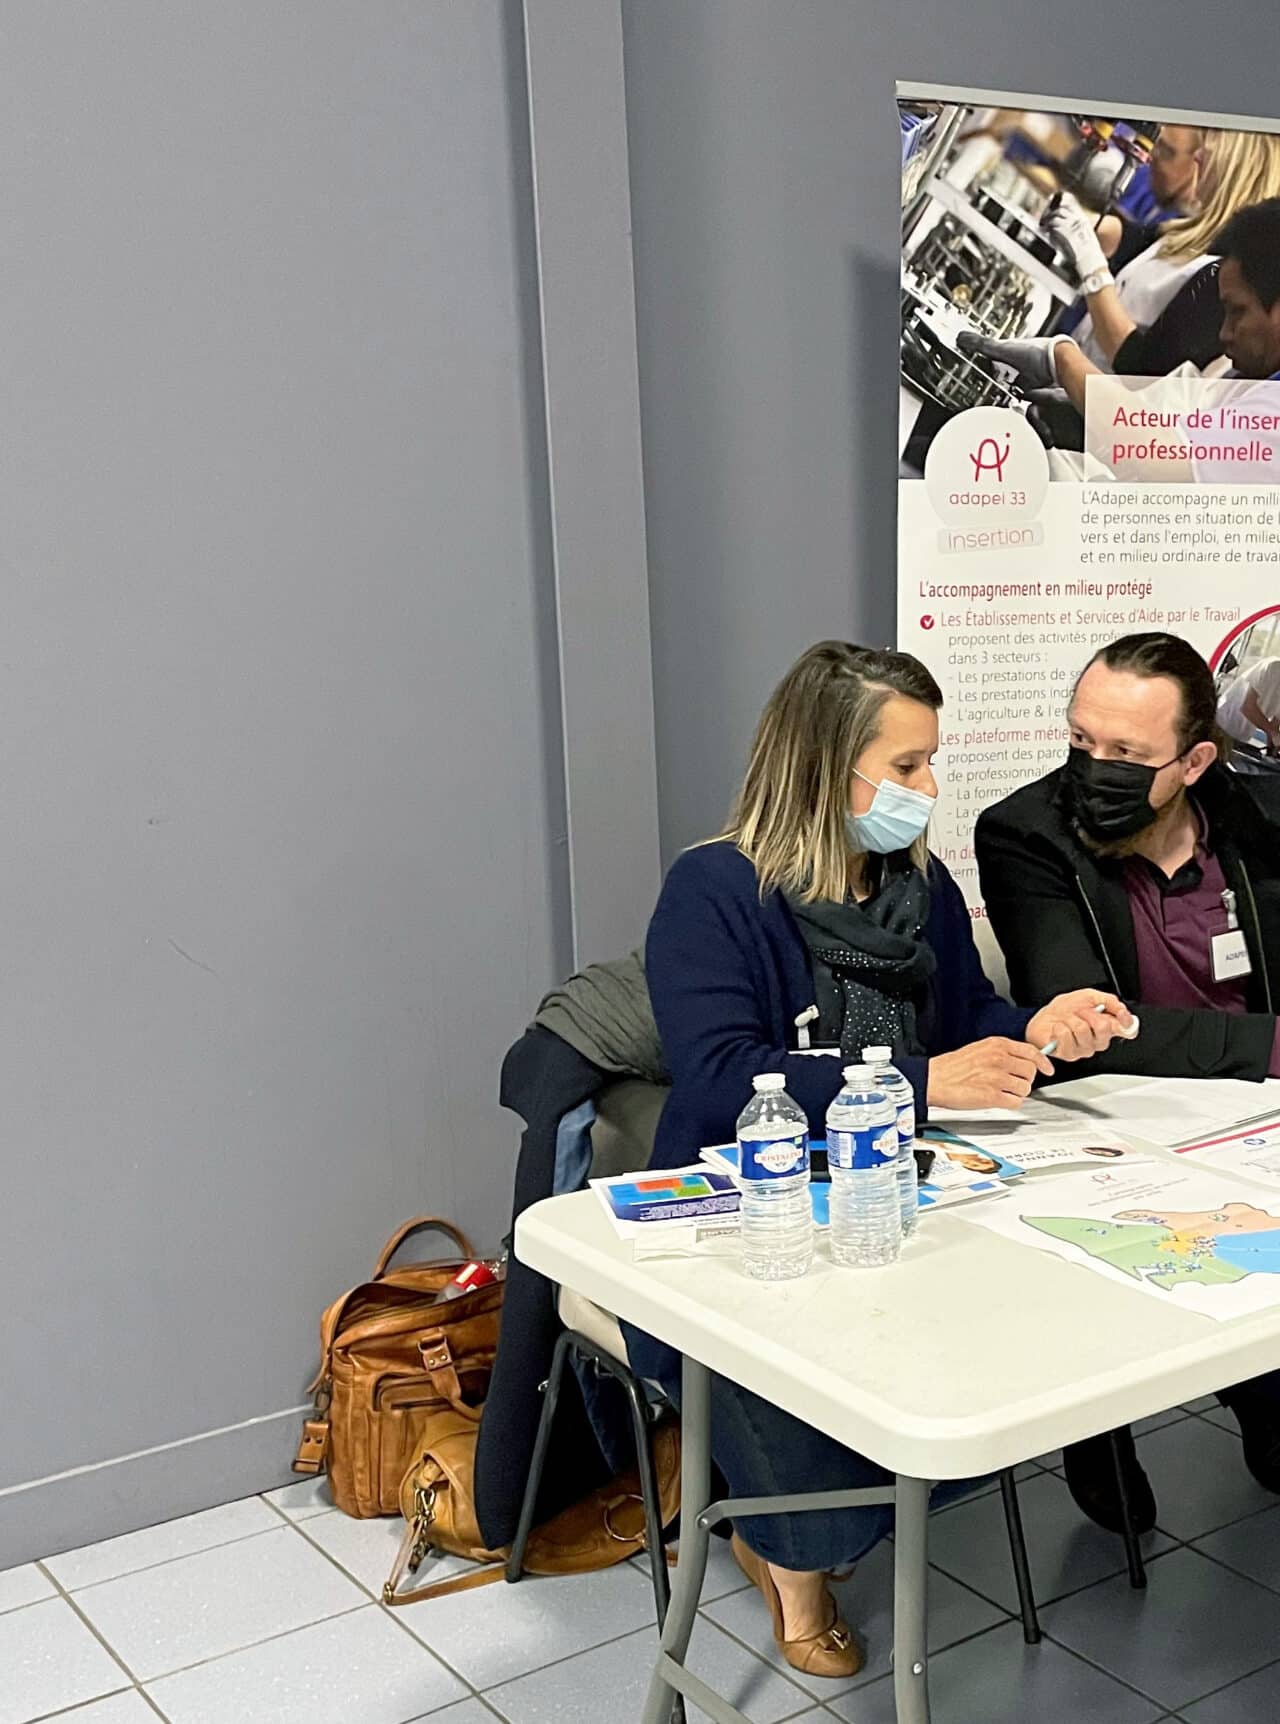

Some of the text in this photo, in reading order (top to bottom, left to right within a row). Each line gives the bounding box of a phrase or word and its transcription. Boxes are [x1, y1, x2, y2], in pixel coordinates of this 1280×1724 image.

[1112, 406, 1181, 428] Acteur
[1186, 410, 1212, 429] de
[1112, 439, 1273, 464] professionnelle
[949, 491, 1026, 507] adapei 33
[1081, 491, 1138, 508] L'Adapei
[1143, 494, 1227, 509] accompagne
[1231, 494, 1248, 505] un
[1081, 512, 1099, 524] de
[1103, 512, 1170, 527] personnes
[1175, 513, 1191, 524] en
[1197, 512, 1252, 525] situation
[1257, 511, 1274, 525] de
[1081, 532, 1109, 544] vers
[1113, 531, 1125, 544] et
[1130, 530, 1160, 544] dans
[1164, 530, 1220, 547] l'emploi,
[1224, 532, 1241, 544] en
[1080, 551, 1093, 563] et
[1098, 551, 1115, 563] en
[1120, 550, 1158, 563] milieu
[1162, 549, 1220, 563] ordinaire
[1225, 549, 1242, 563] de
[919, 580, 1153, 601] L'accompagnement en milieu protégé
[941, 606, 1241, 627] Les Établissements et Services d'Aide par le Travail
[948, 632, 1010, 648] proposent
[1014, 631, 1035, 644] des
[1038, 630, 1087, 645] activités
[948, 651, 1041, 666] dans 3 secteurs
[958, 671, 978, 684] Les
[982, 669, 1046, 685] prestations
[1050, 668, 1066, 681] de
[958, 690, 977, 702] Les
[981, 688, 1046, 703] prestations
[958, 707, 1031, 724] L'agriculture
[1034, 704, 1044, 718] &
[940, 730, 960, 746] Les
[964, 727, 1031, 747] plateforme
[947, 749, 1008, 765] proposent
[1012, 747, 1033, 761] des
[947, 770, 963, 783] de
[957, 788, 970, 800] La
[956, 807, 969, 819] La
[939, 847, 956, 861] Un
